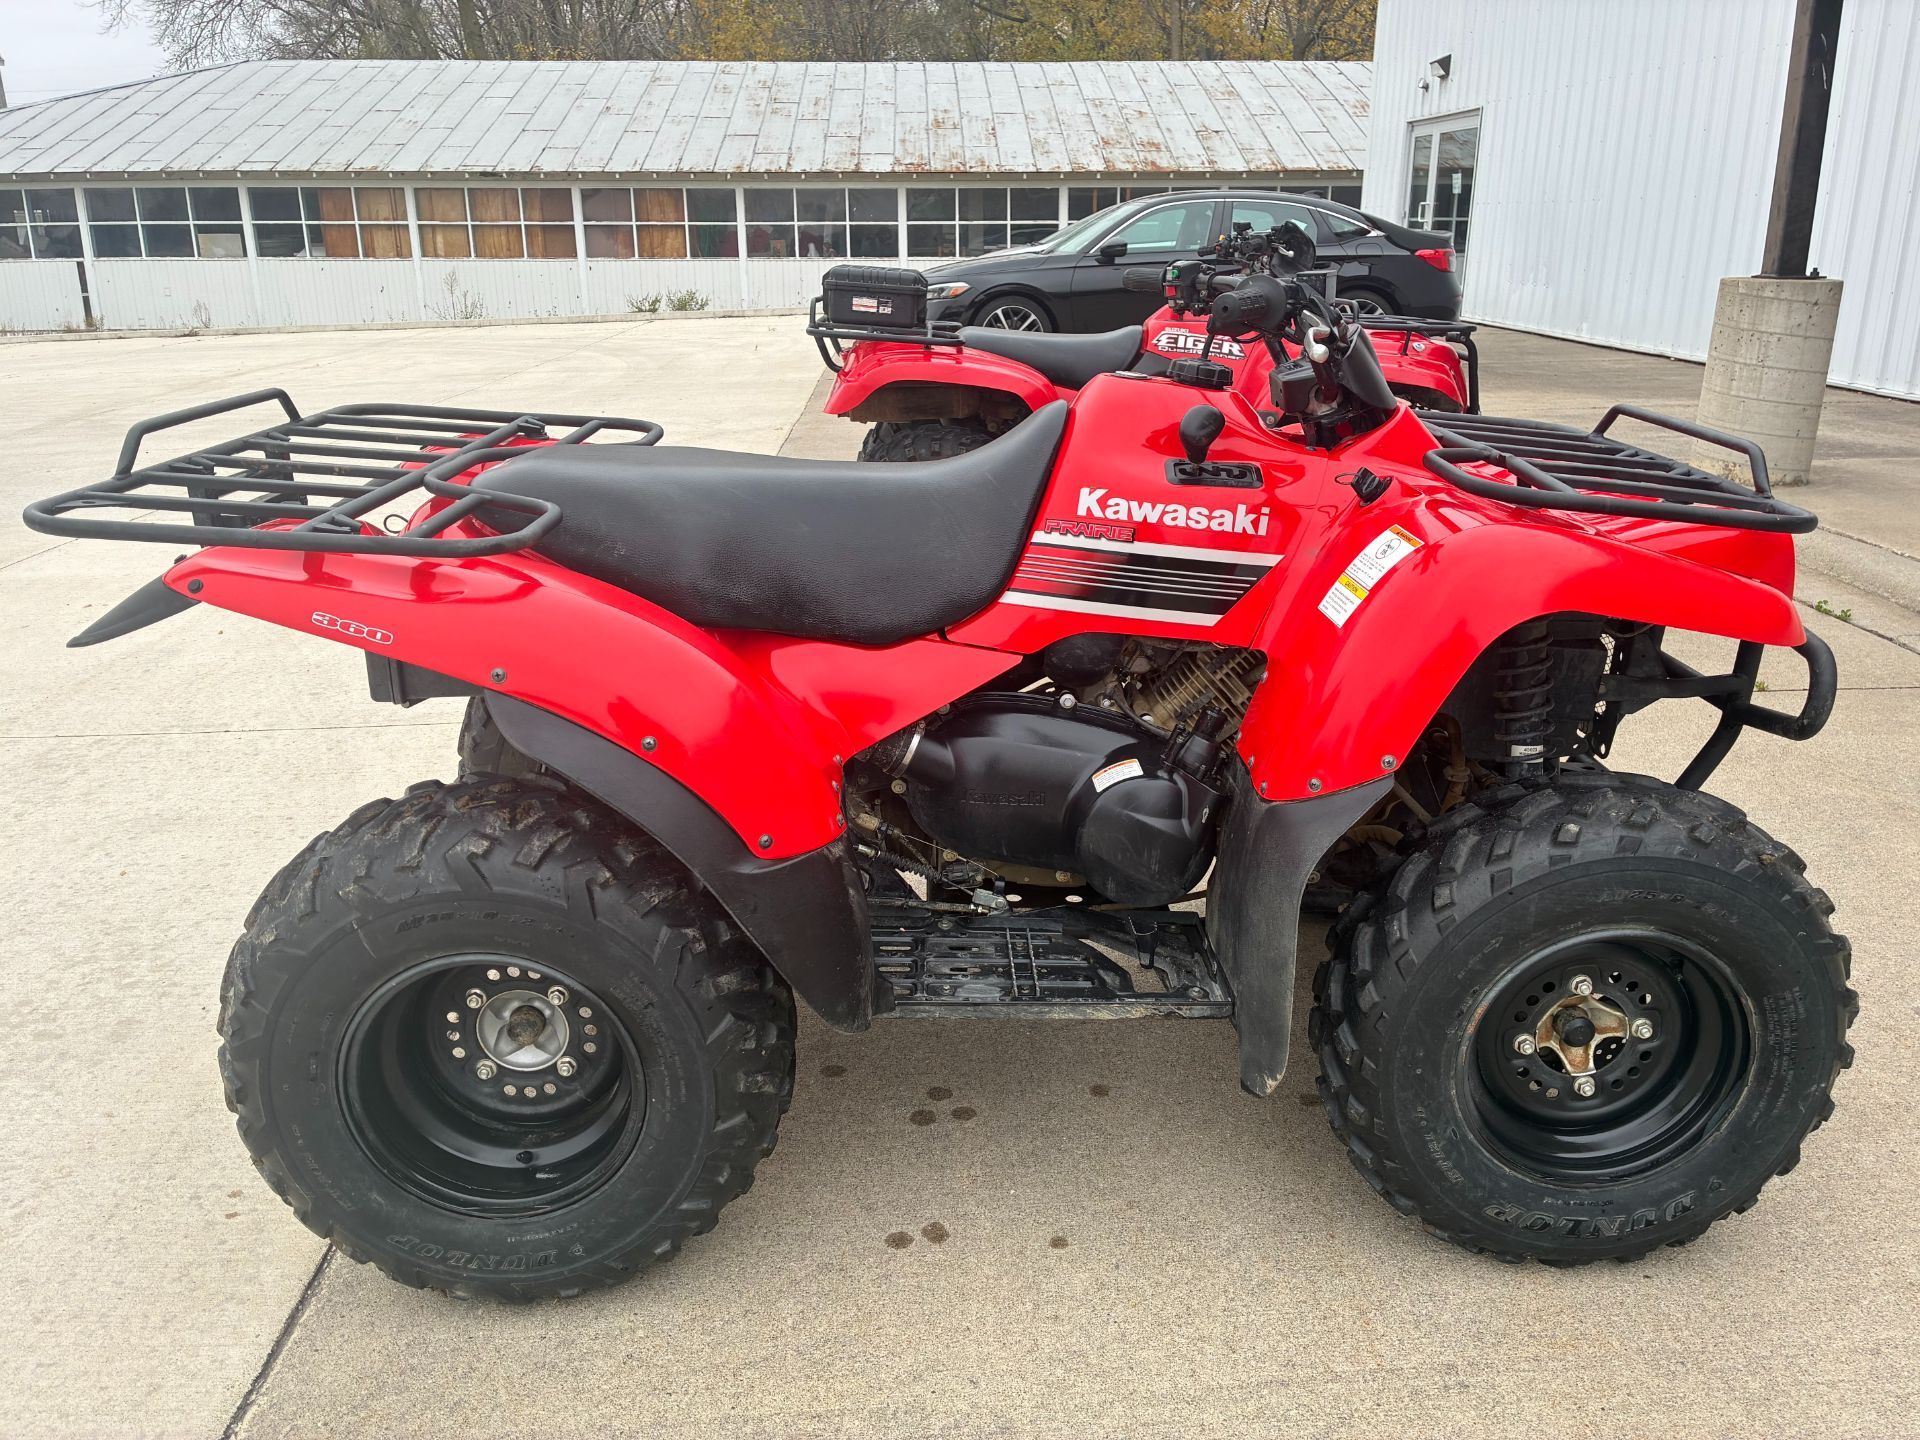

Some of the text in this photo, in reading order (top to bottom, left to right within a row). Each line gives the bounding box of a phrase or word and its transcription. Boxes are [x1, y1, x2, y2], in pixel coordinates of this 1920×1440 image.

[1154, 332, 1246, 356] EIGER
[1076, 487, 1271, 536] Kawasaki
[1044, 519, 1136, 542] PRAIRIE
[312, 611, 394, 645] 360
[961, 787, 1046, 807] Kawasaki
[1482, 1190, 1697, 1239] DUNLOP
[386, 1233, 558, 1270] DUNLOP
